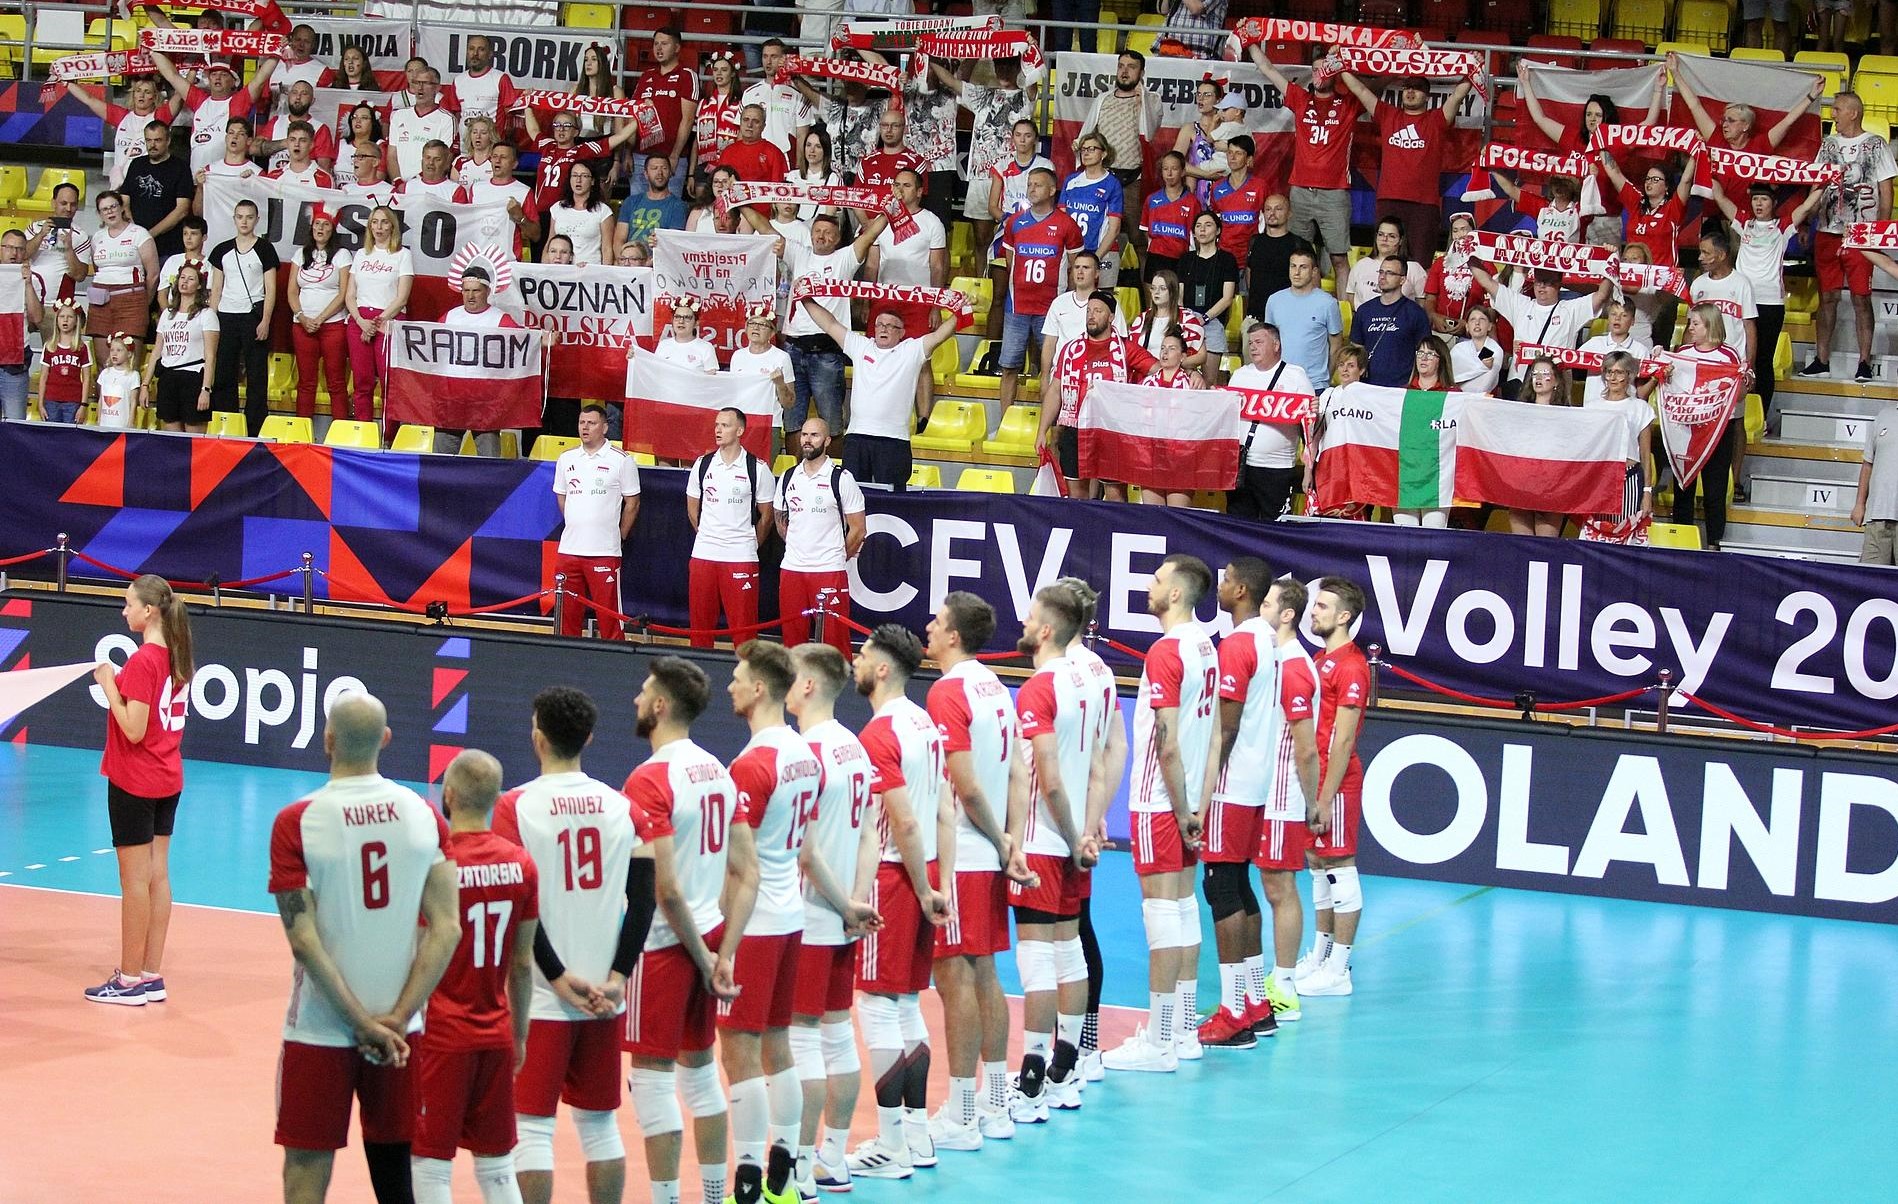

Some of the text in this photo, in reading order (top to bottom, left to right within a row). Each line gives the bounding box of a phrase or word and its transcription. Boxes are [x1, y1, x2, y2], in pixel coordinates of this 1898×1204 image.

[895, 18, 955, 31] TOBIE ODDANI
[1277, 19, 1374, 47] POLSKA
[61, 59, 102, 74] POL
[448, 33, 583, 81] LBORK
[1350, 49, 1469, 76] POLSKA
[812, 59, 898, 89] POLSKA
[530, 90, 636, 116] POLSKA
[655, 89, 669, 97] plus
[1325, 117, 1340, 126] plus
[1309, 126, 1329, 145] 34
[1388, 136, 1425, 149] adidas
[1608, 125, 1695, 151] POLSKA
[1490, 145, 1577, 175] POLSKA
[1717, 151, 1832, 183] POLSKA
[544, 164, 561, 187] 12
[757, 186, 878, 206] POL SKA
[1073, 202, 1100, 213] UNIQA
[1229, 213, 1253, 222] UNIQA
[1161, 226, 1185, 237] UNIQA
[109, 250, 128, 259] plus
[1028, 247, 1055, 256] UNIQA
[360, 260, 393, 273] Polska
[1024, 259, 1046, 284] 16
[519, 277, 645, 315] POZNAŃ
[171, 321, 188, 330] KTO
[522, 308, 637, 350] POLSKA
[163, 331, 190, 344] WYGRA
[402, 325, 531, 369] RADOM
[1092, 360, 1109, 369] plus
[1550, 346, 1603, 367] POLS
[1845, 425, 1858, 437] V
[728, 496, 744, 504] plus
[1812, 490, 1831, 503] IV
[1366, 554, 1734, 708] Volley
[343, 801, 400, 827] KUREK
[550, 796, 605, 816] JANUSZ
[700, 793, 725, 856] 10
[786, 791, 813, 850] 15
[1361, 733, 1898, 904] OLAND
[557, 827, 603, 891] 19
[361, 841, 390, 909] 6
[456, 862, 524, 889] ZATORSKI
[467, 900, 514, 968] 17
